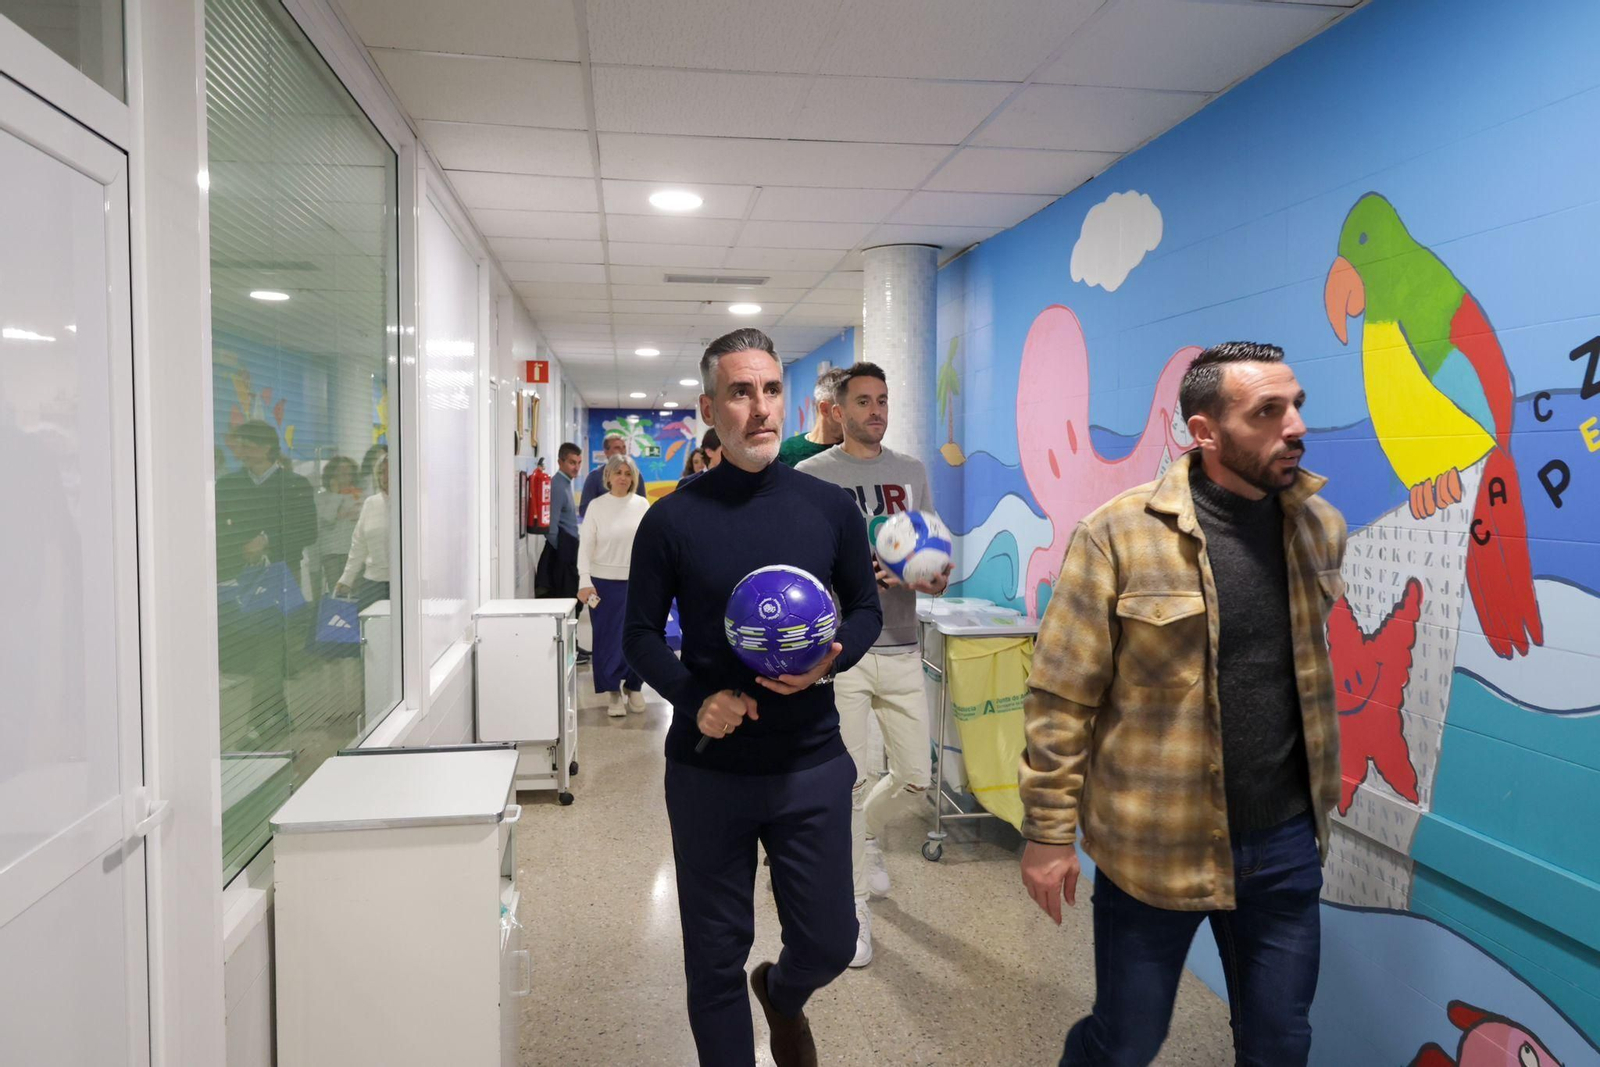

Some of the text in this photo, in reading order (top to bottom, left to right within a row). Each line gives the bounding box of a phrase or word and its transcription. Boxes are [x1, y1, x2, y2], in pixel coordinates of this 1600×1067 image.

[1569, 335, 1600, 400] Z
[1533, 391, 1554, 423] C
[1579, 416, 1600, 453] E
[1488, 476, 1508, 507] A
[1537, 459, 1571, 509] P
[1470, 518, 1491, 546] C
